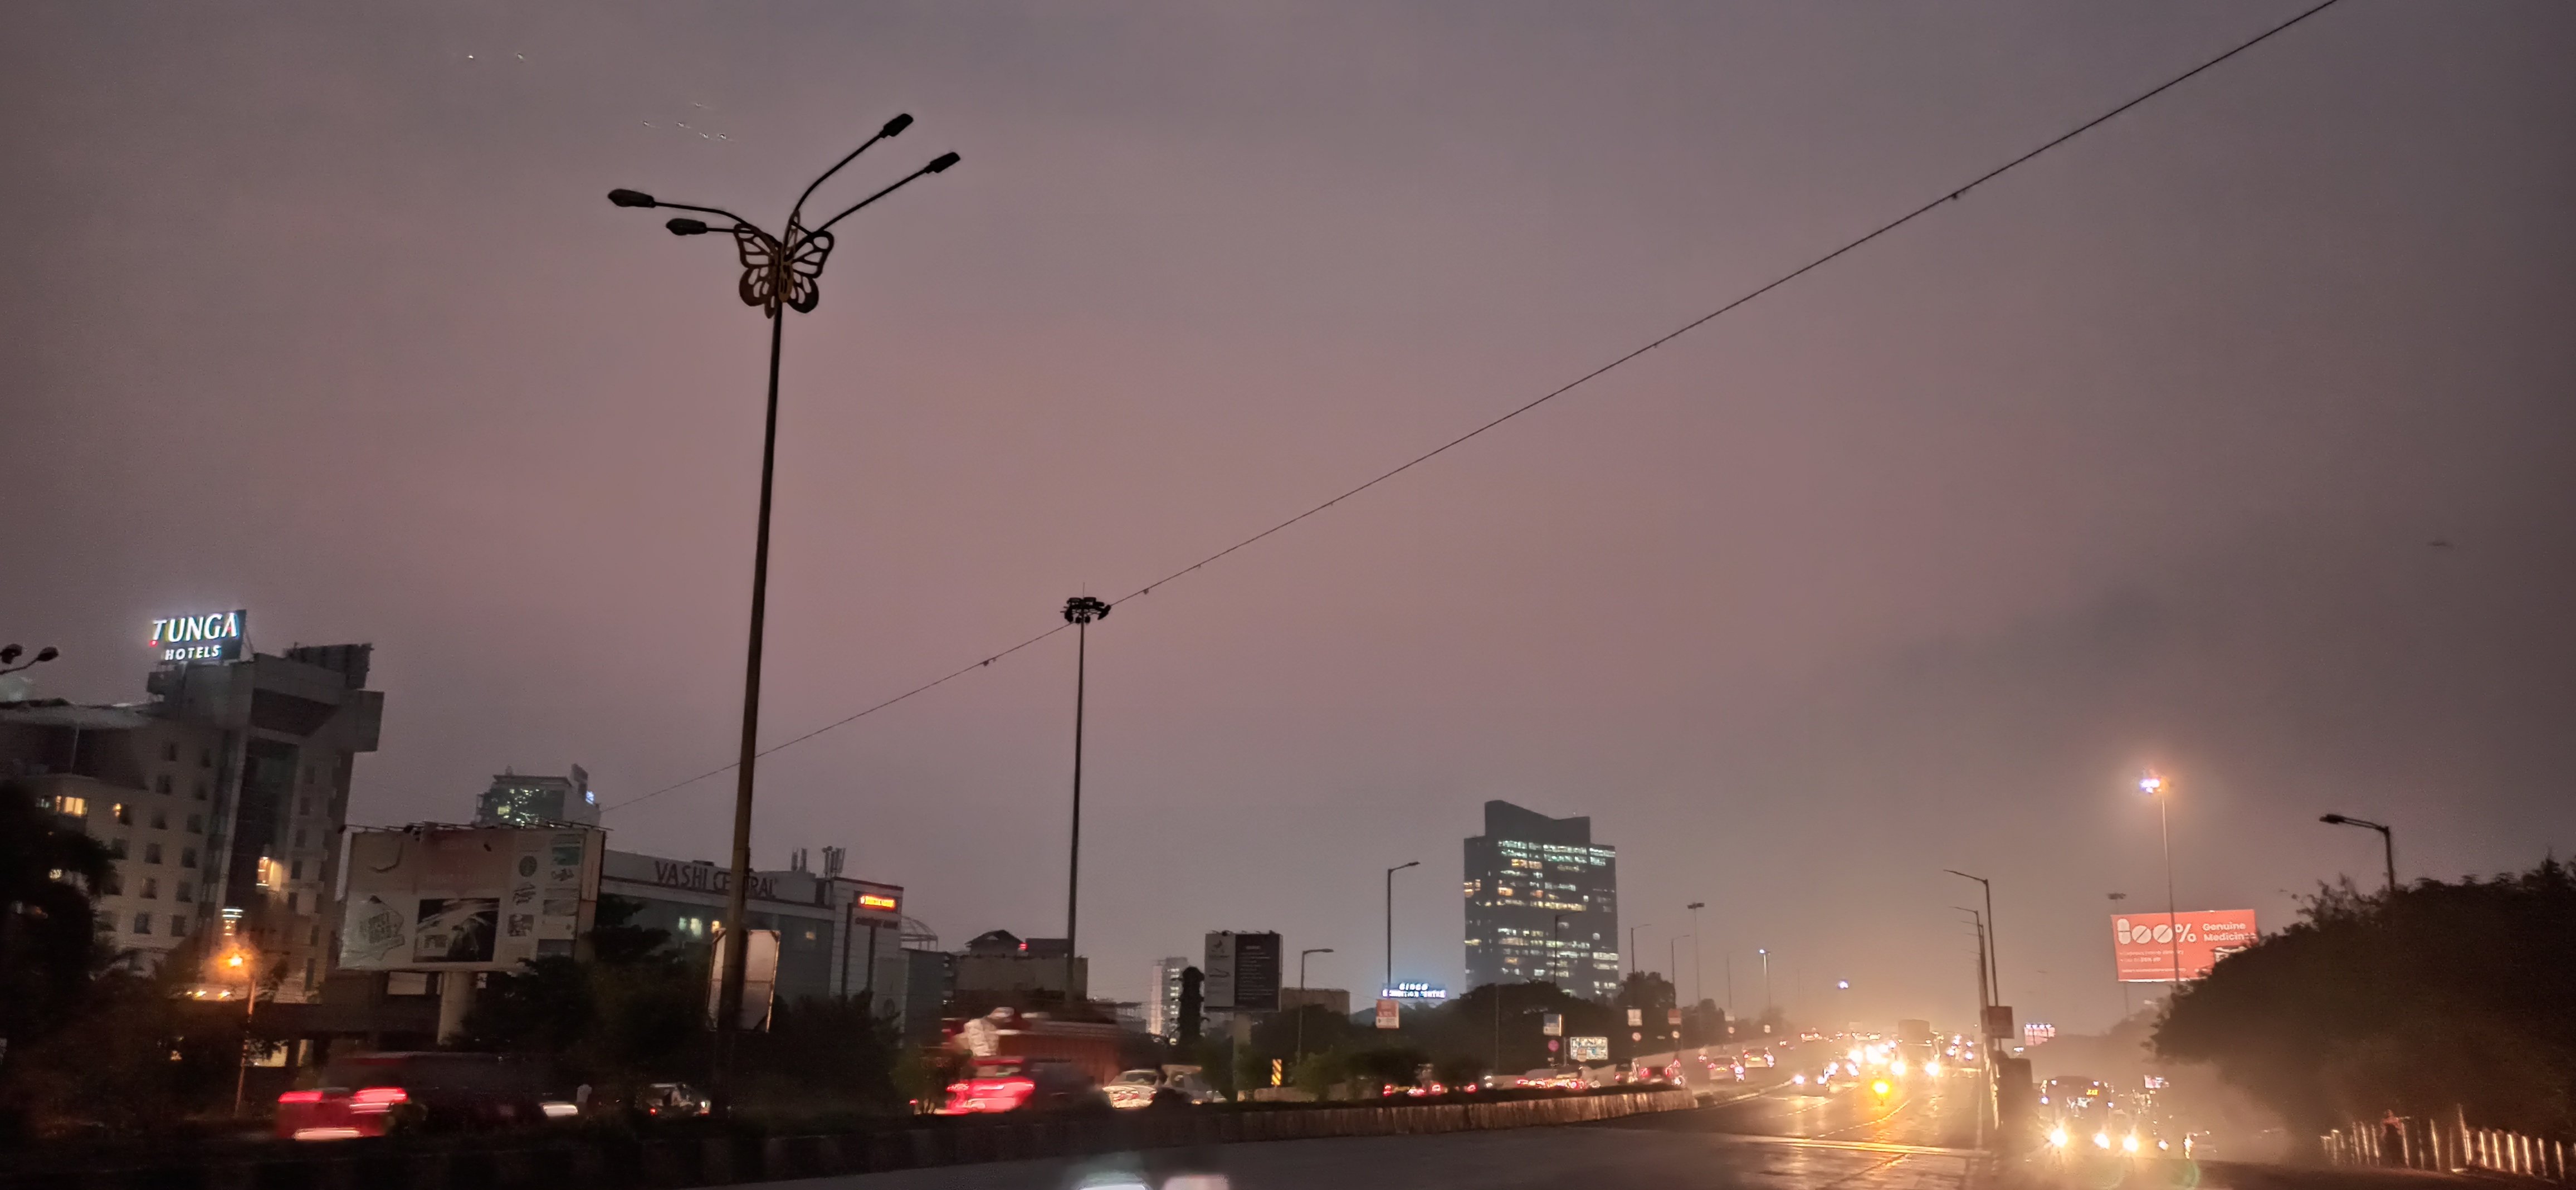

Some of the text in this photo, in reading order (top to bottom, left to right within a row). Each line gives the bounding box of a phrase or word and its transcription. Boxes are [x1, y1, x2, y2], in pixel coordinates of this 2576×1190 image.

[152, 612, 239, 642] TUNGA
[164, 644, 222, 661] HOTELS
[655, 860, 776, 898] VASHI CERAL
[2117, 918, 2197, 945] 100%
[2202, 921, 2247, 931] Genuine
